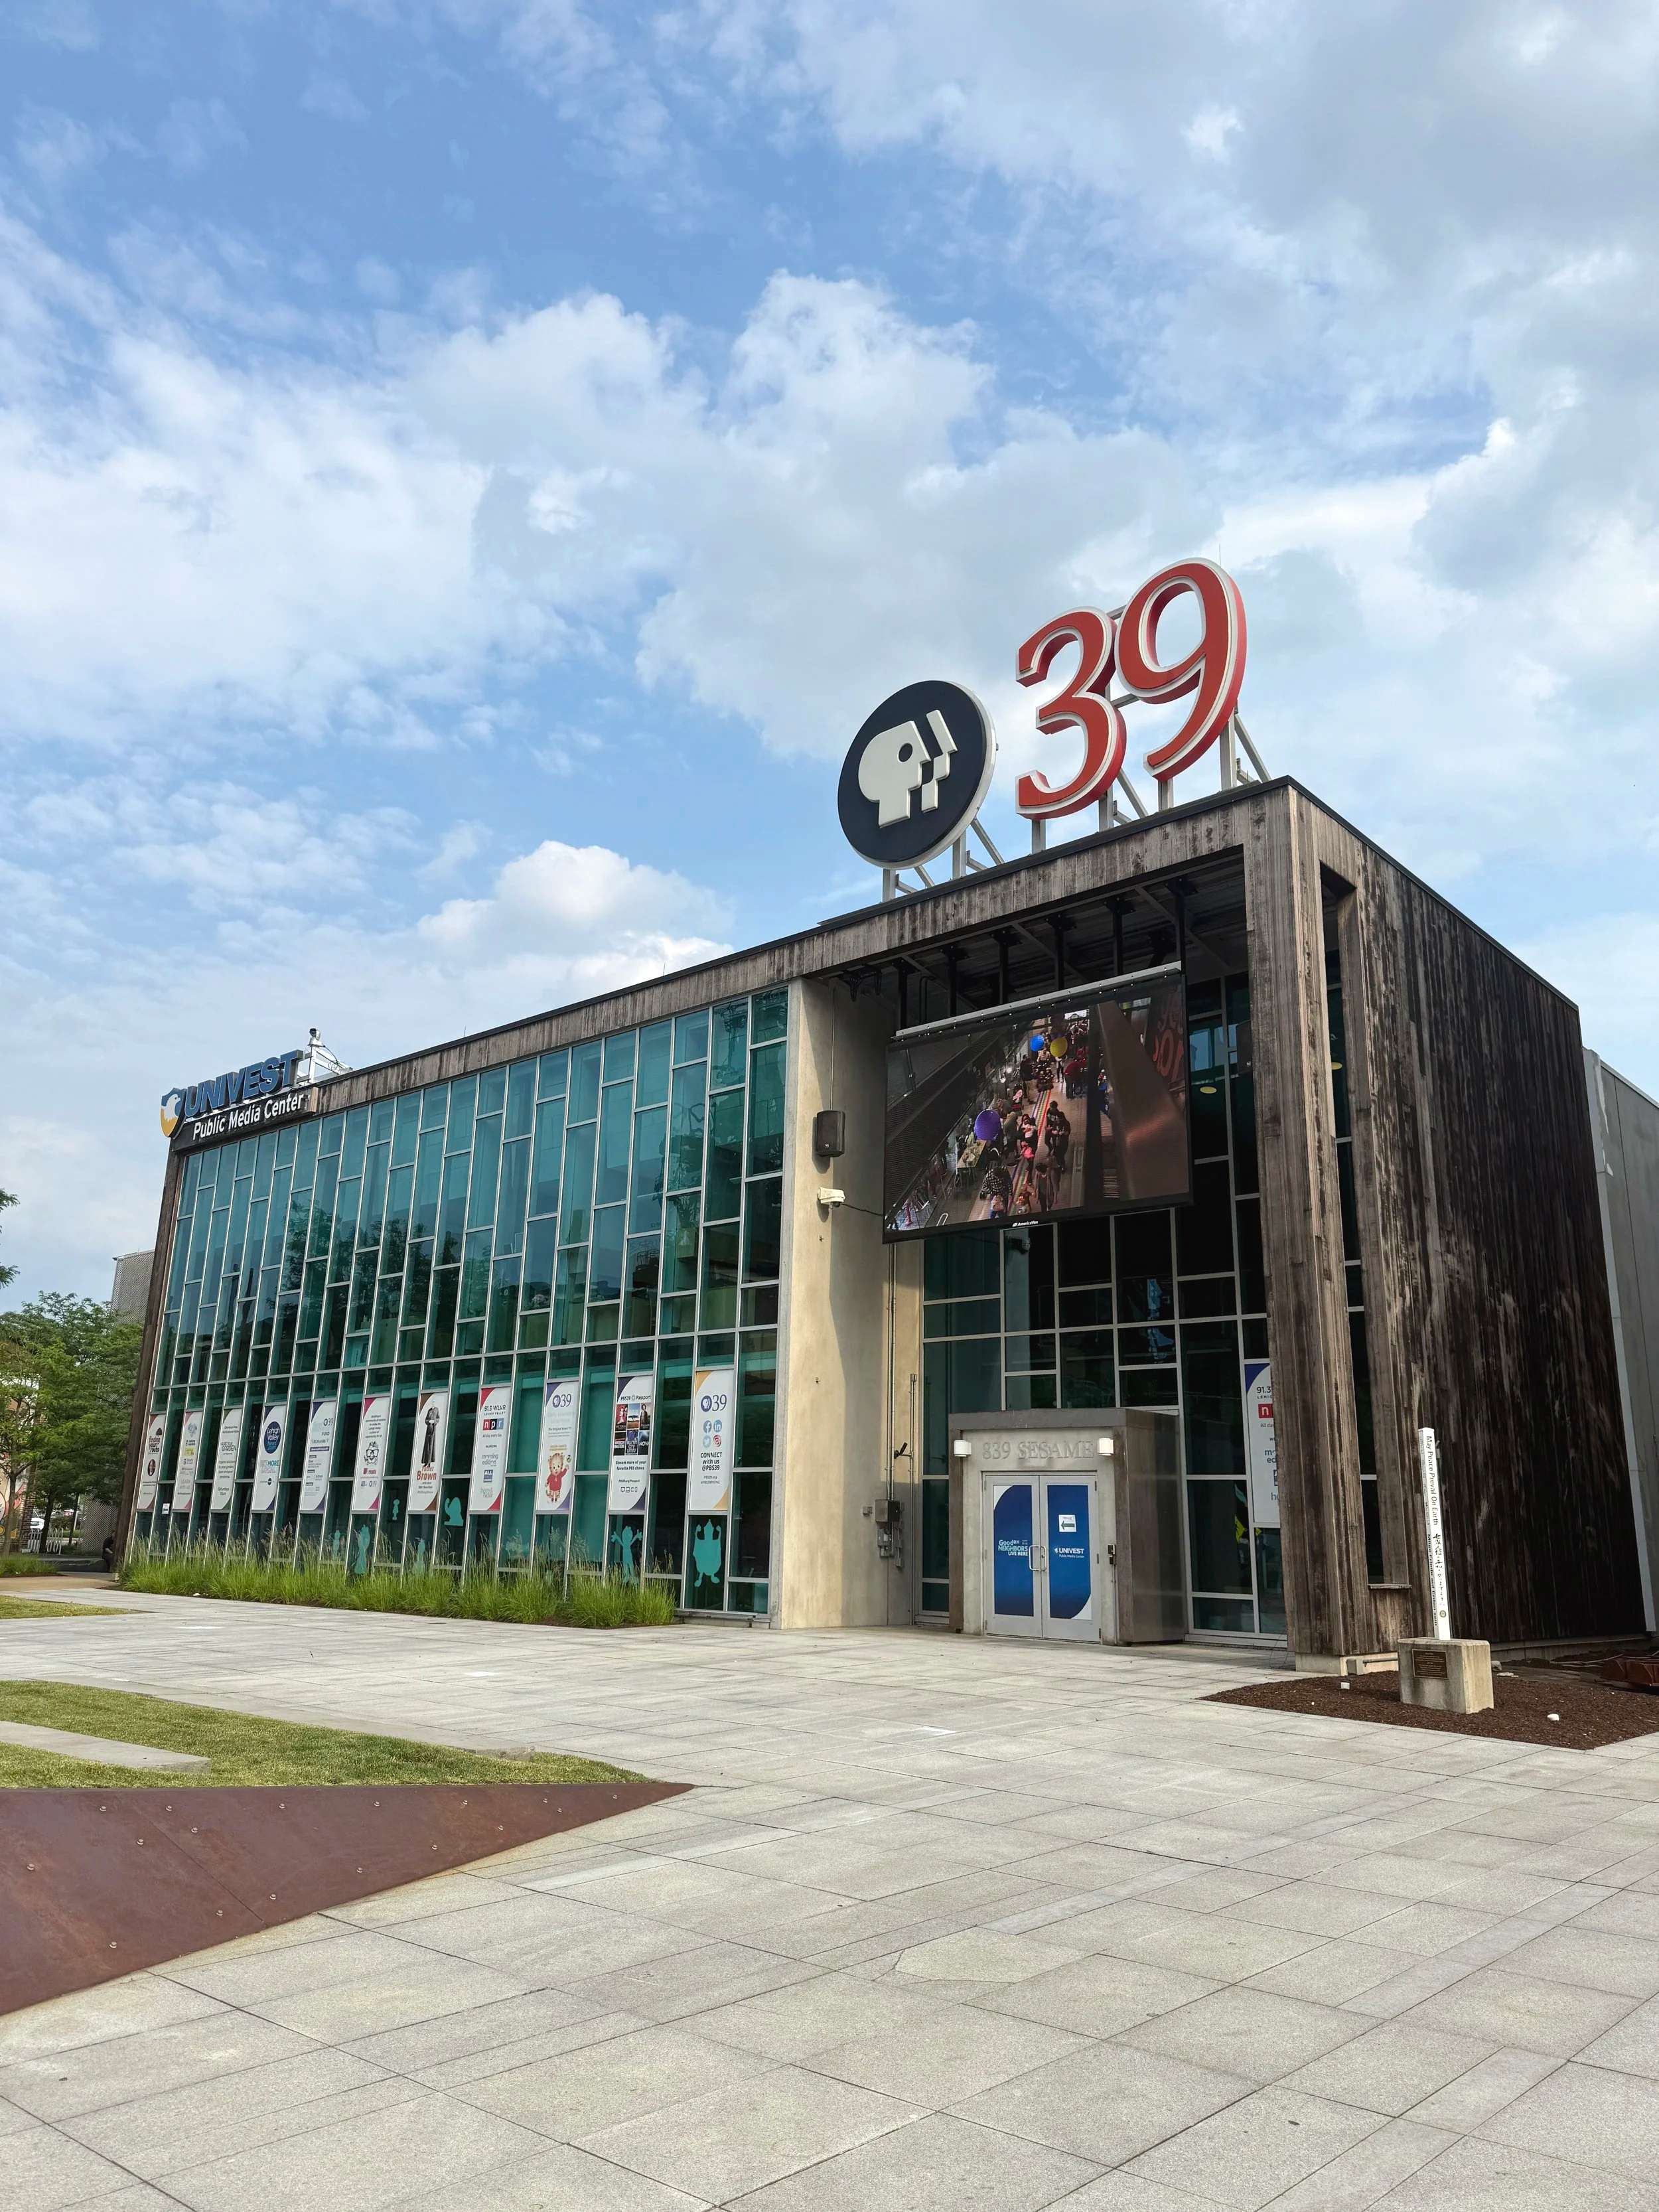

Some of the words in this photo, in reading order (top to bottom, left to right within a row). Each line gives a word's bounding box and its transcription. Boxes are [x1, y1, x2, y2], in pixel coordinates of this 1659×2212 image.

[1015, 557, 1248, 820] 39
[184, 1049, 303, 1118] UNIVEST
[192, 1114, 226, 1140] Public
[228, 1104, 261, 1130] Media
[263, 1093, 305, 1120] Center
[560, 1393, 572, 1408] 39
[712, 1394, 727, 1412] 39
[484, 1420, 503, 1430] npr
[267, 1434, 279, 1442] Valley
[982, 1441, 1011, 1459] 839
[1017, 1440, 1094, 1459] SESAME
[417, 1470, 437, 1481] Brown
[1431, 1497, 1437, 1505] On
